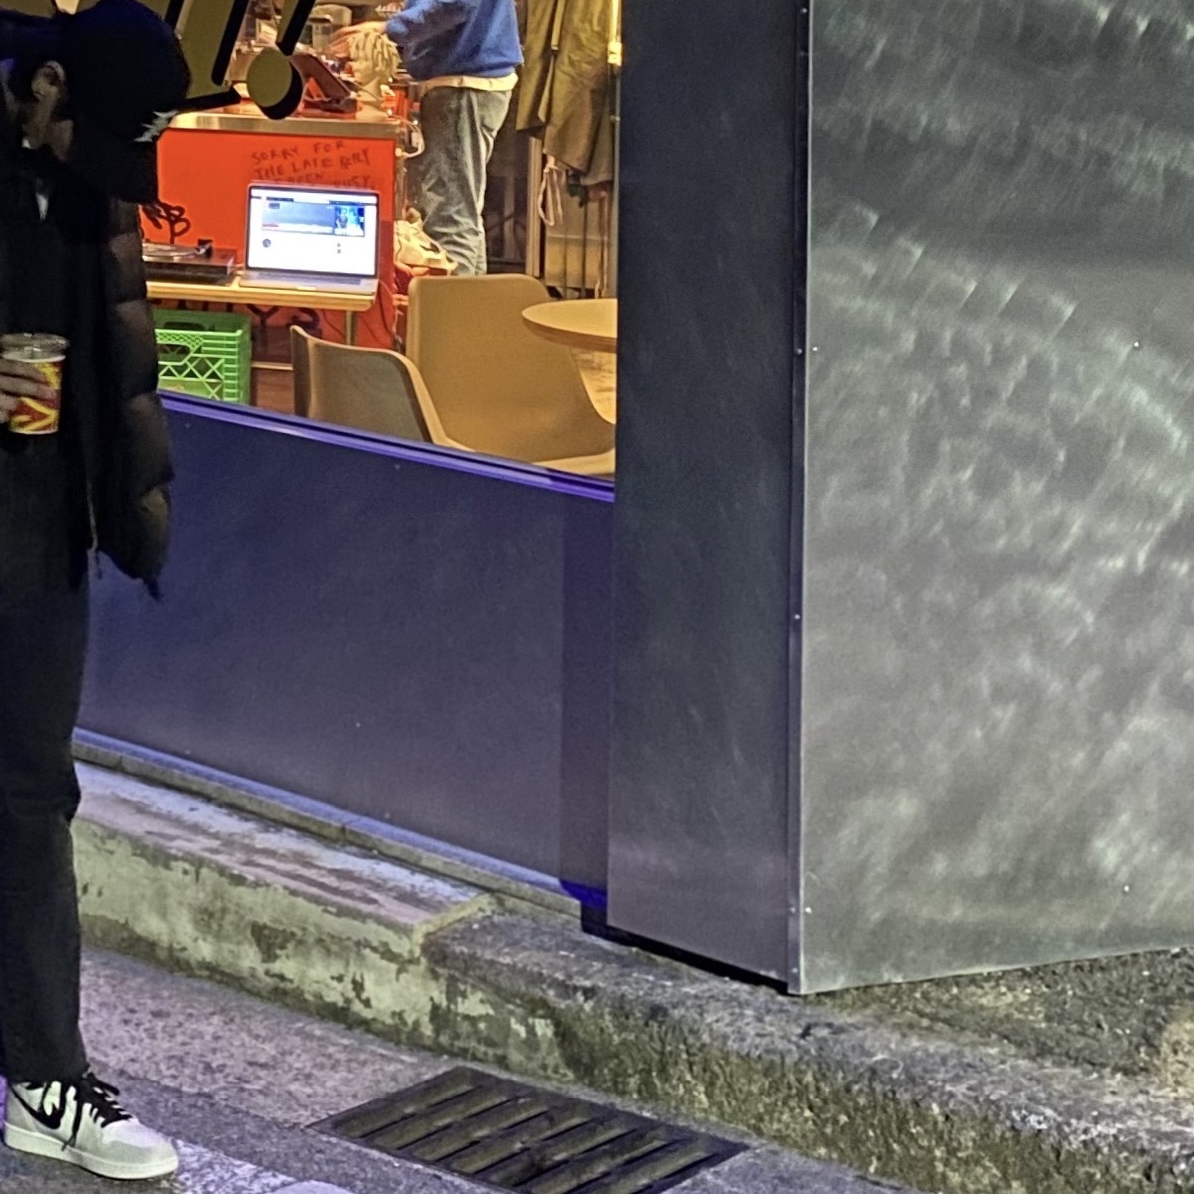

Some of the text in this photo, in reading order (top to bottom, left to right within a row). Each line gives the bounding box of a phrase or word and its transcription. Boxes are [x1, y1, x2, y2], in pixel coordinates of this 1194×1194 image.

[252, 140, 345, 165] SORRY FOR
[254, 164, 284, 180] THE
[292, 157, 332, 172] LATE
